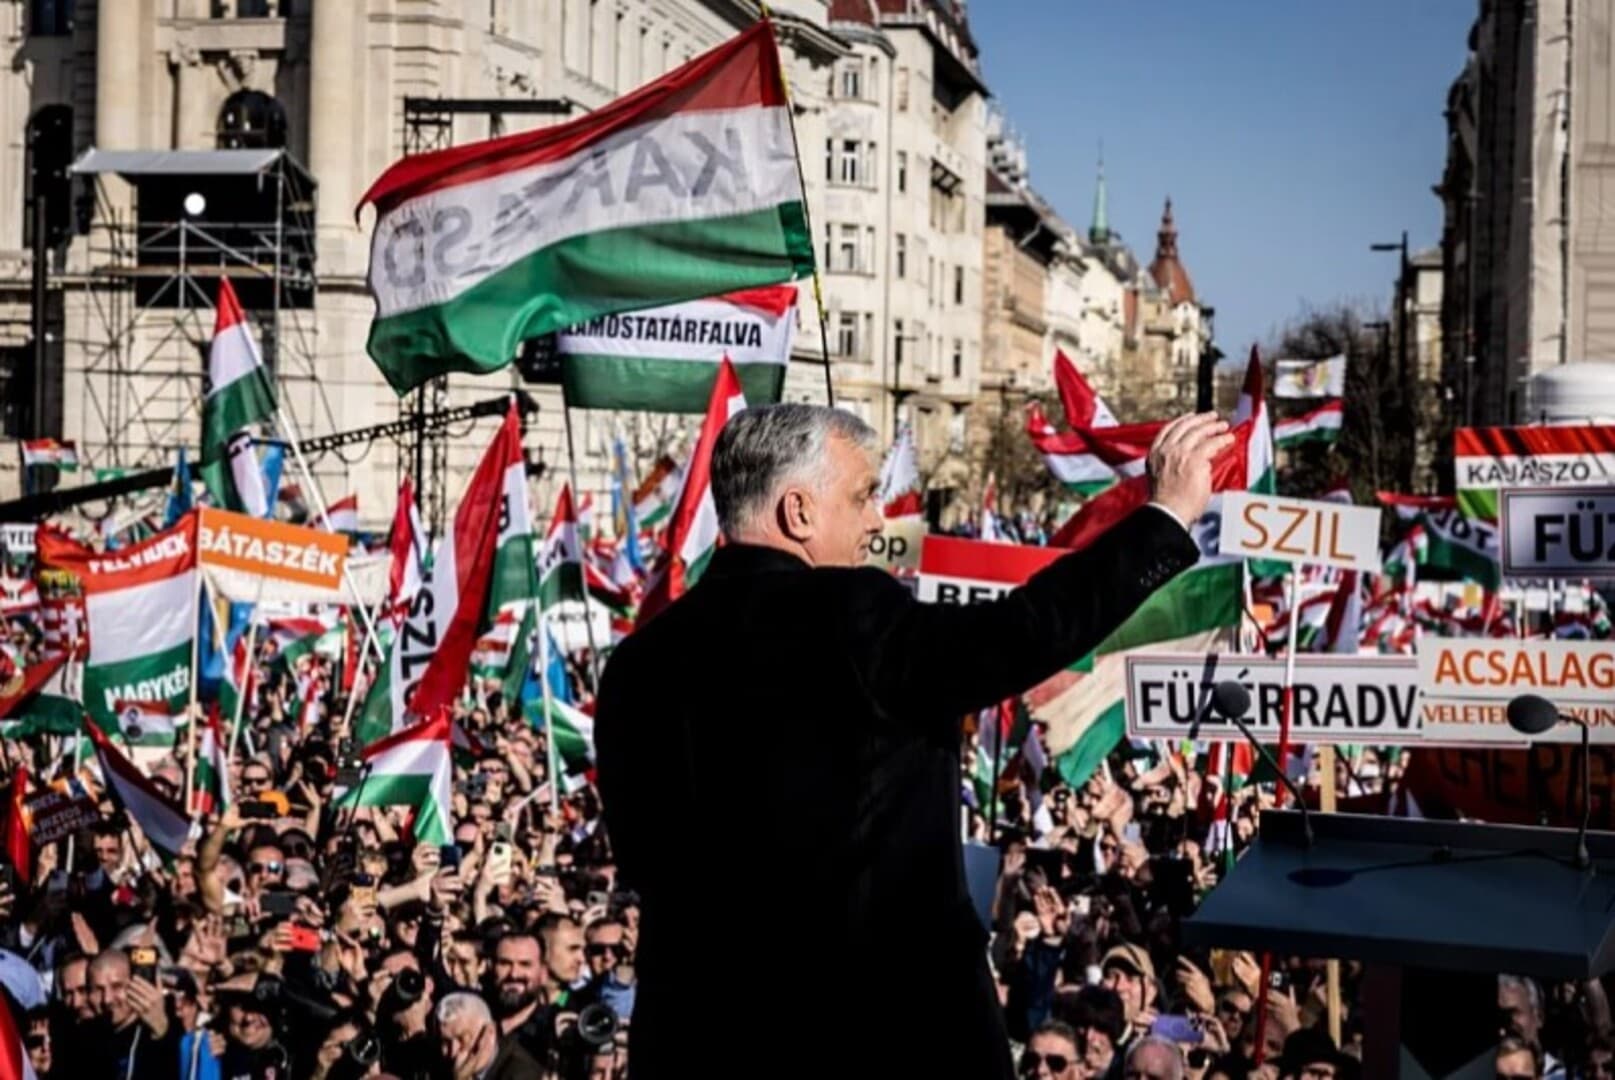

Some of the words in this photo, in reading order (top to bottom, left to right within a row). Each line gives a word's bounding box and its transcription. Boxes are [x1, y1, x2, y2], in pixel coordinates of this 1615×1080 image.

[199, 525, 339, 577] BÁTASZÉK
[869, 535, 907, 561] op
[1241, 502, 1355, 560] SZIL
[1535, 501, 1615, 562] FÜ
[1435, 650, 1615, 688] ACSALAG
[1140, 668, 1421, 729] FÜZÉRRADV
[1423, 704, 1509, 724] VELETE
